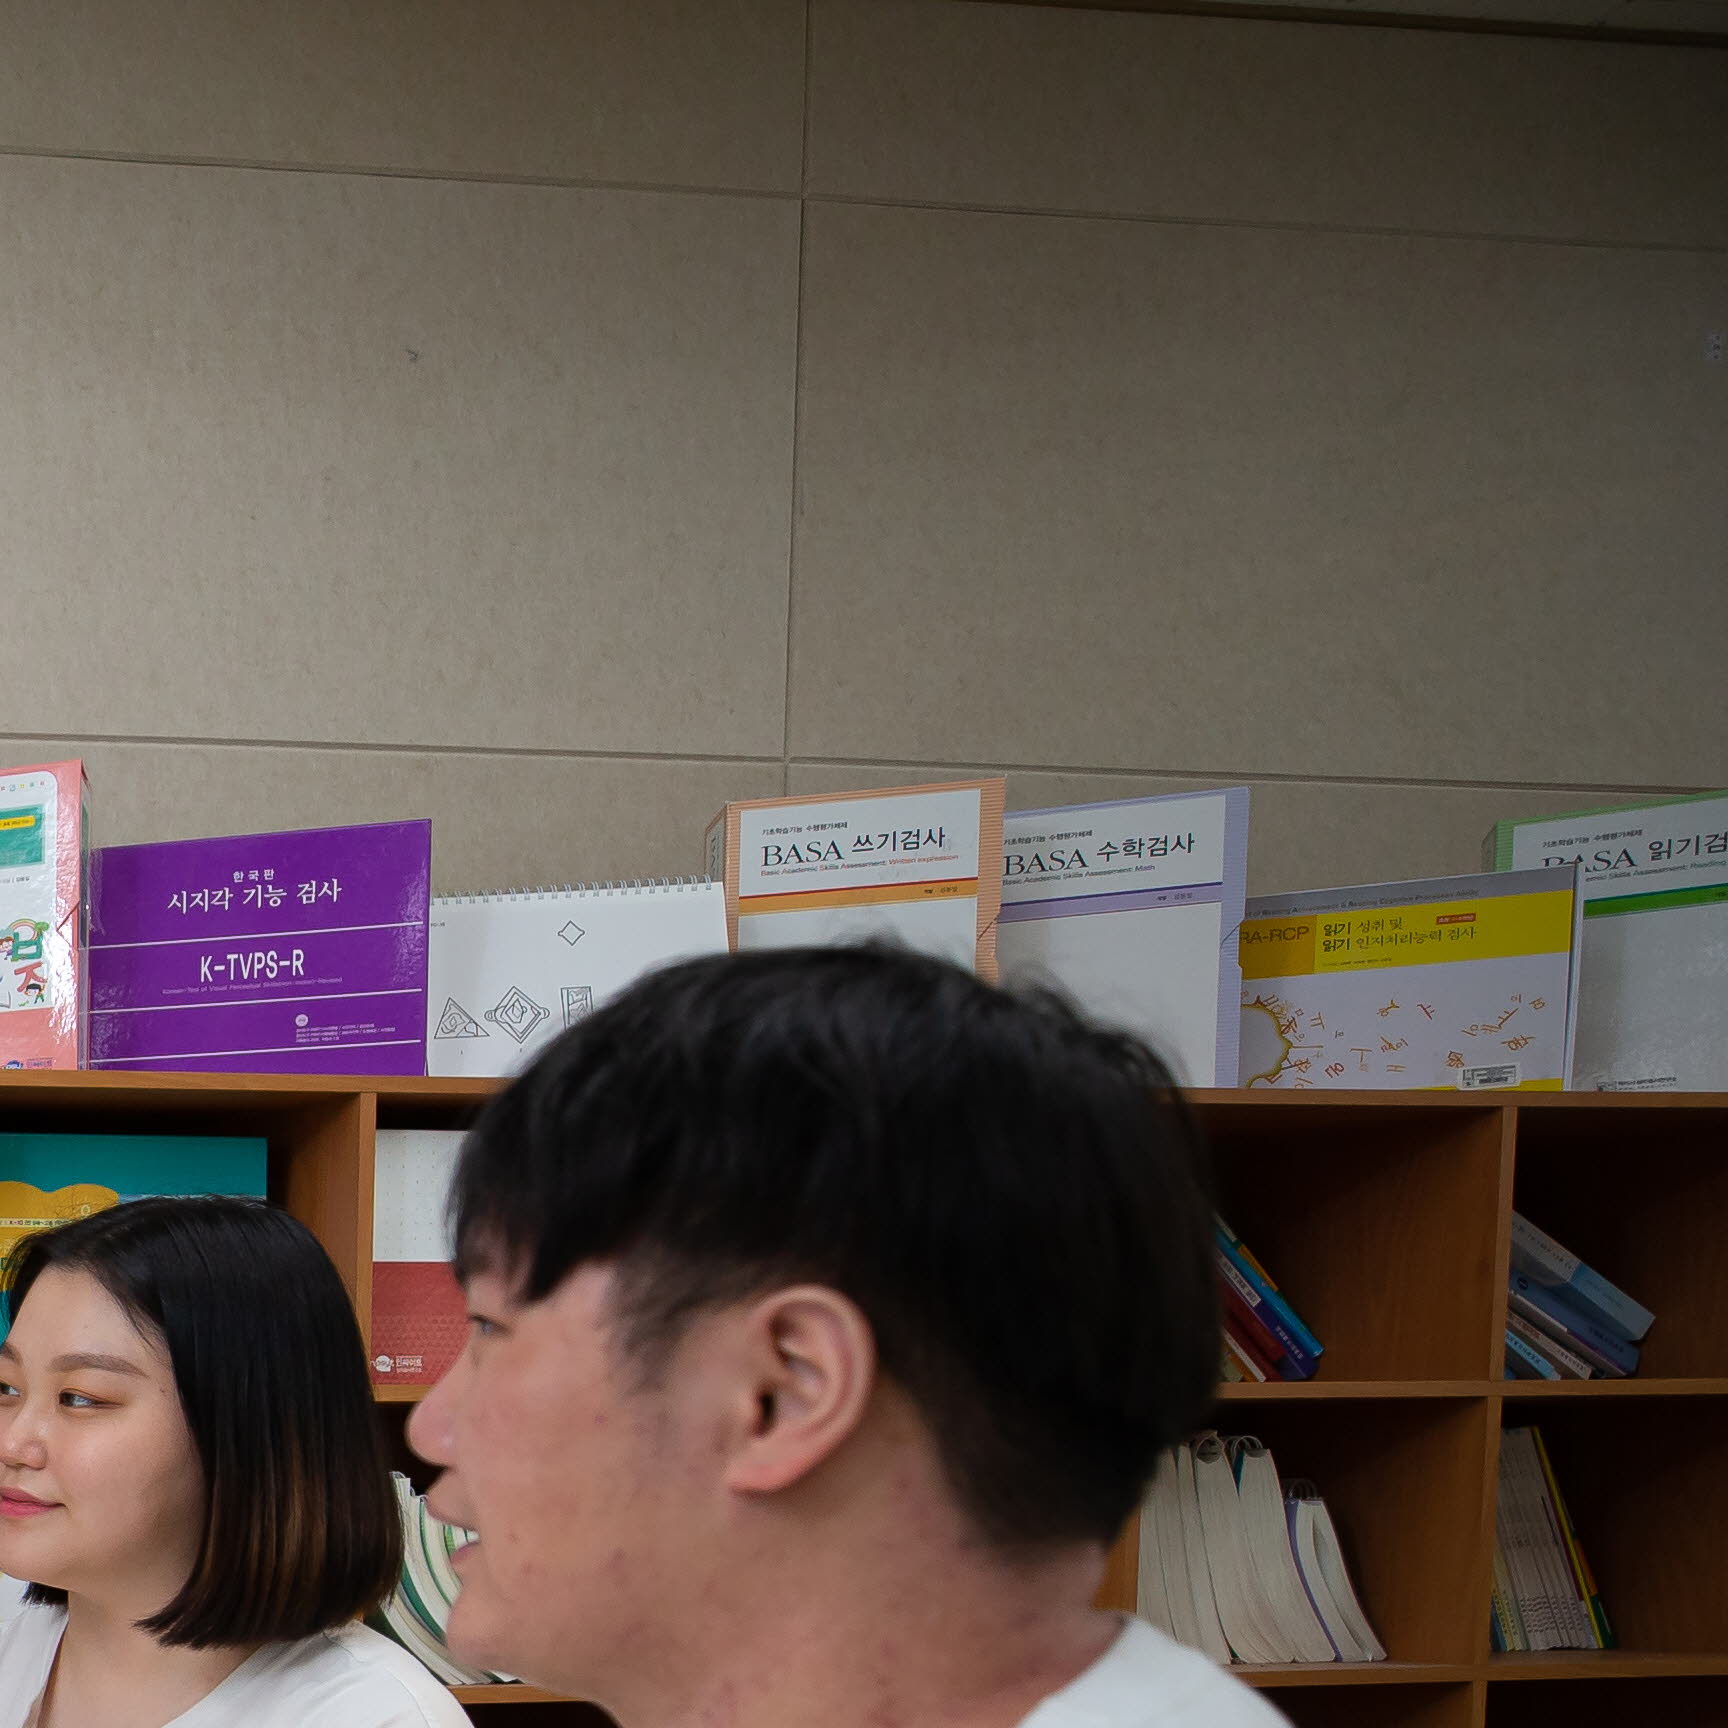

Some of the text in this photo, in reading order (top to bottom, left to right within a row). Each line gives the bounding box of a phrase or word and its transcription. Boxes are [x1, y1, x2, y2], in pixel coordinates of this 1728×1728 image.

[761, 827, 946, 867] BASA 쓰기검사
[1004, 833, 1194, 876] BASA 수학검사
[761, 869, 780, 877] Basic
[782, 867, 817, 875] Academic
[819, 864, 838, 872] Skills
[1024, 875, 1061, 884] Academic
[1063, 872, 1082, 880] Skills
[1135, 864, 1155, 872] Math
[167, 878, 341, 915] 시지각 기능 검사
[1323, 938, 1350, 952] 읽기
[1447, 924, 1477, 941] 검사
[1324, 917, 1403, 937] 읽기 성취 및
[200, 949, 304, 983] K-TVPS-R
